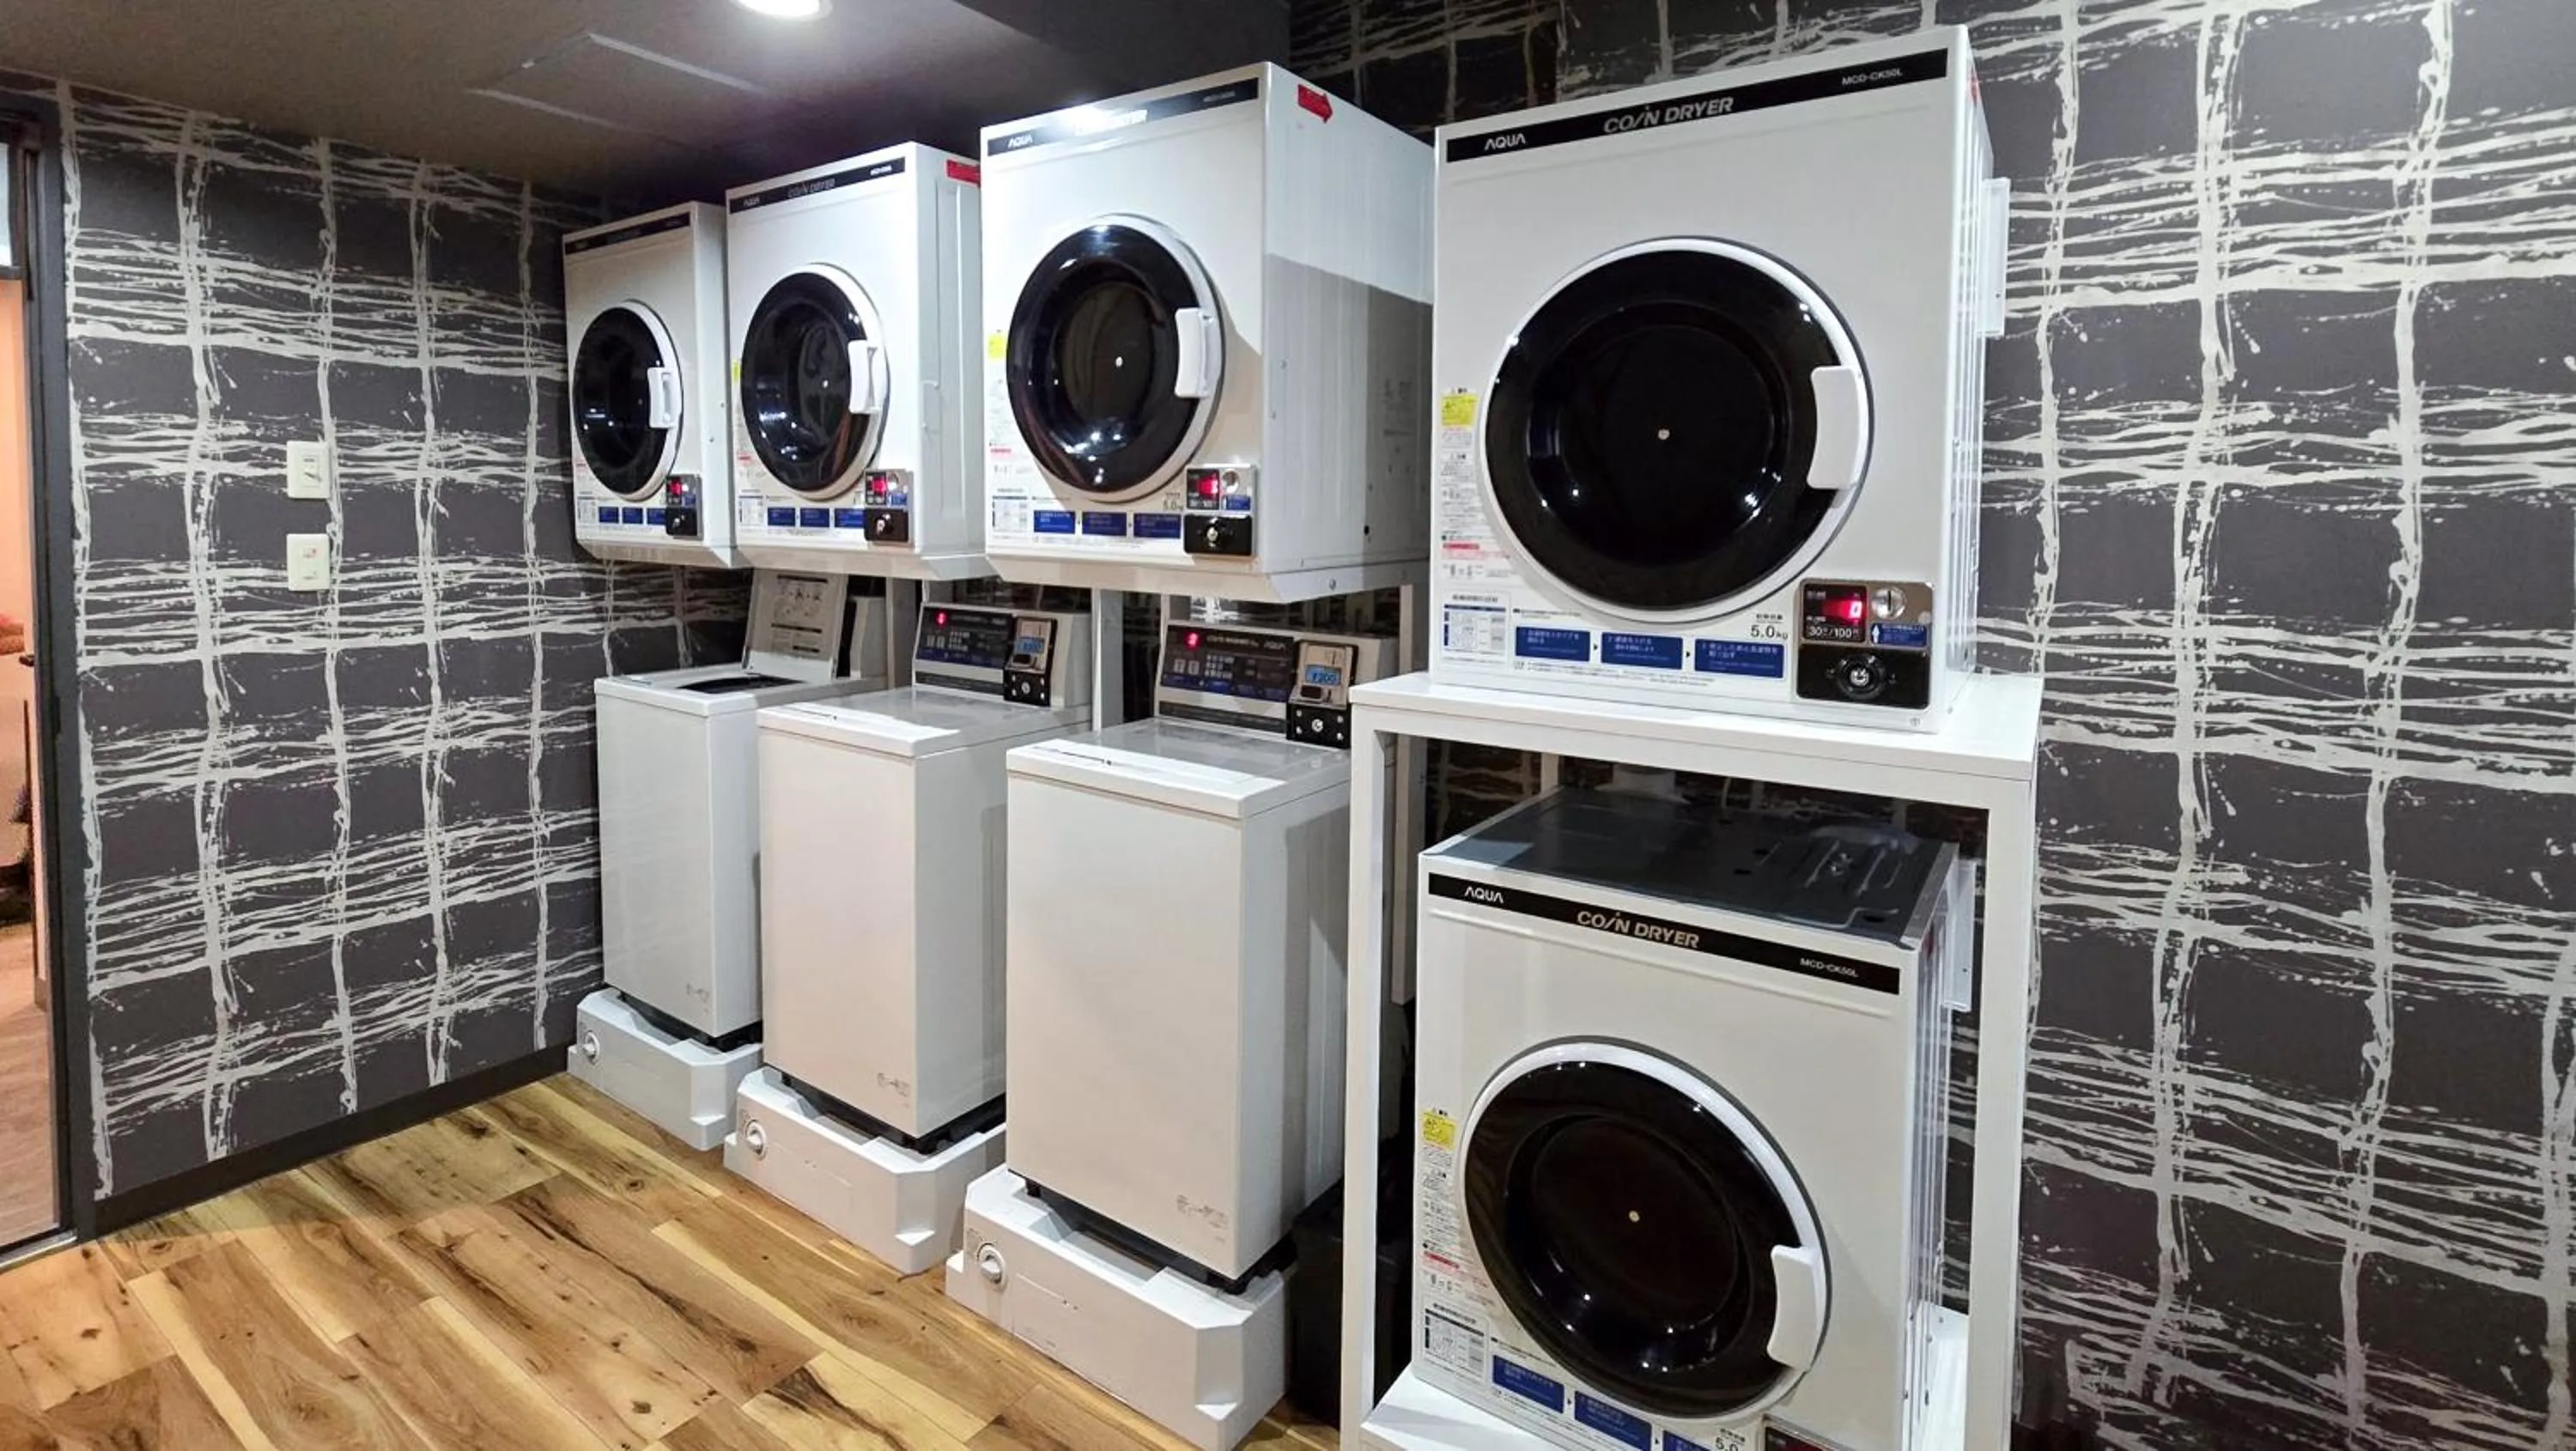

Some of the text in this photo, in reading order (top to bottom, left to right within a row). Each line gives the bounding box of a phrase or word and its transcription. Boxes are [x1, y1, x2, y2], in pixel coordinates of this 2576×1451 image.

[1664, 96, 1734, 124] DRYER
[1484, 133, 1526, 151] AQUA
[1464, 886, 1504, 904] AQUA
[1634, 921, 1700, 949] DRYER
